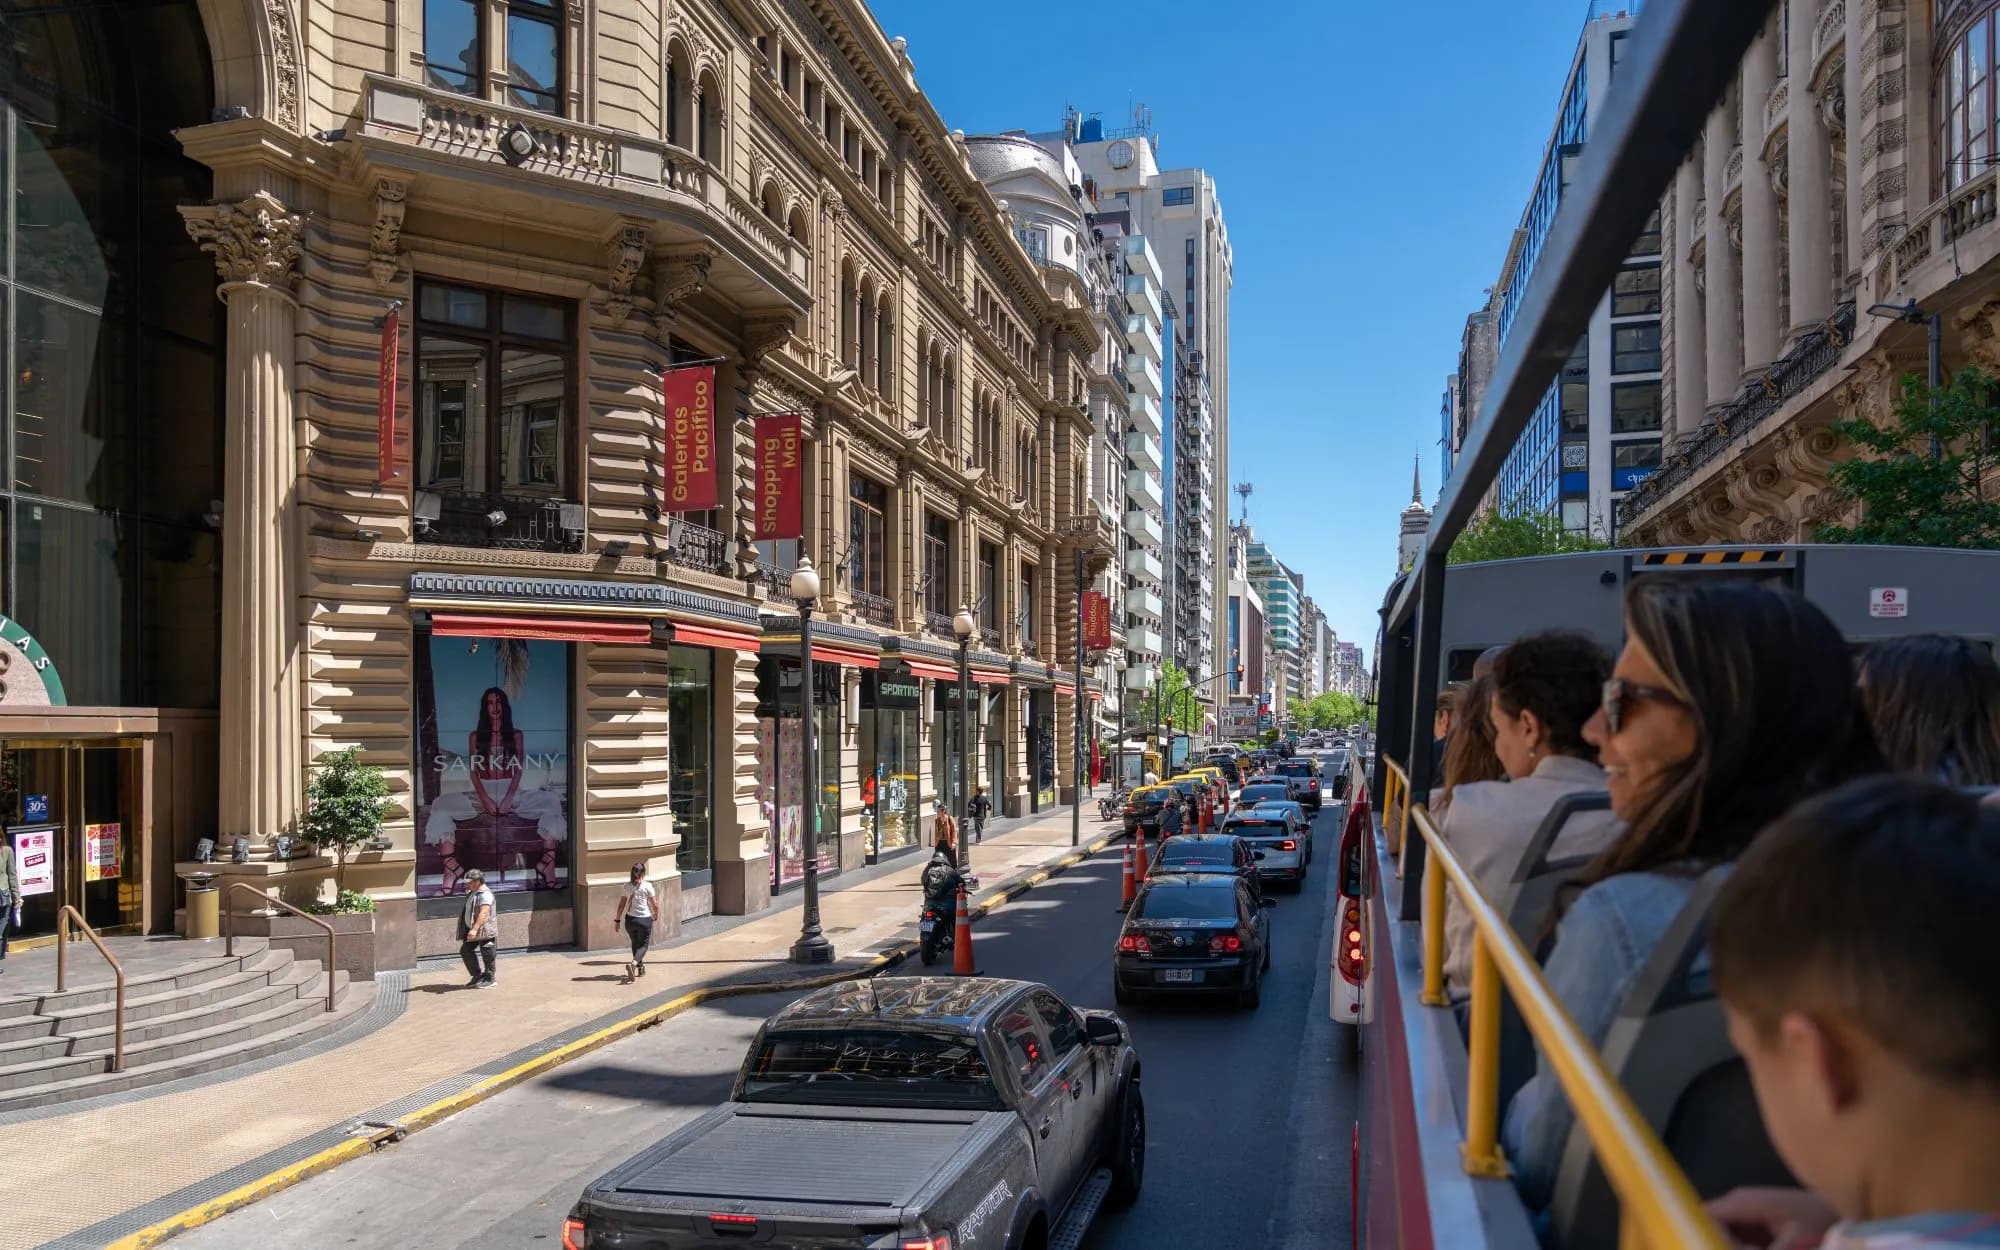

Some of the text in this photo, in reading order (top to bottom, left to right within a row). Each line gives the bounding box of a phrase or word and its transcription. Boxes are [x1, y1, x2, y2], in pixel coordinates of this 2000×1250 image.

[691, 380, 709, 473] Pacífico
[781, 427, 796, 468] Mall
[671, 406, 689, 501] Galerías
[762, 438, 781, 533] Shopping
[881, 682, 919, 697] SPORTING
[949, 687, 979, 699] SPOTING
[433, 753, 559, 772] SARKANY
[959, 1179, 1013, 1244] RAPTOR
